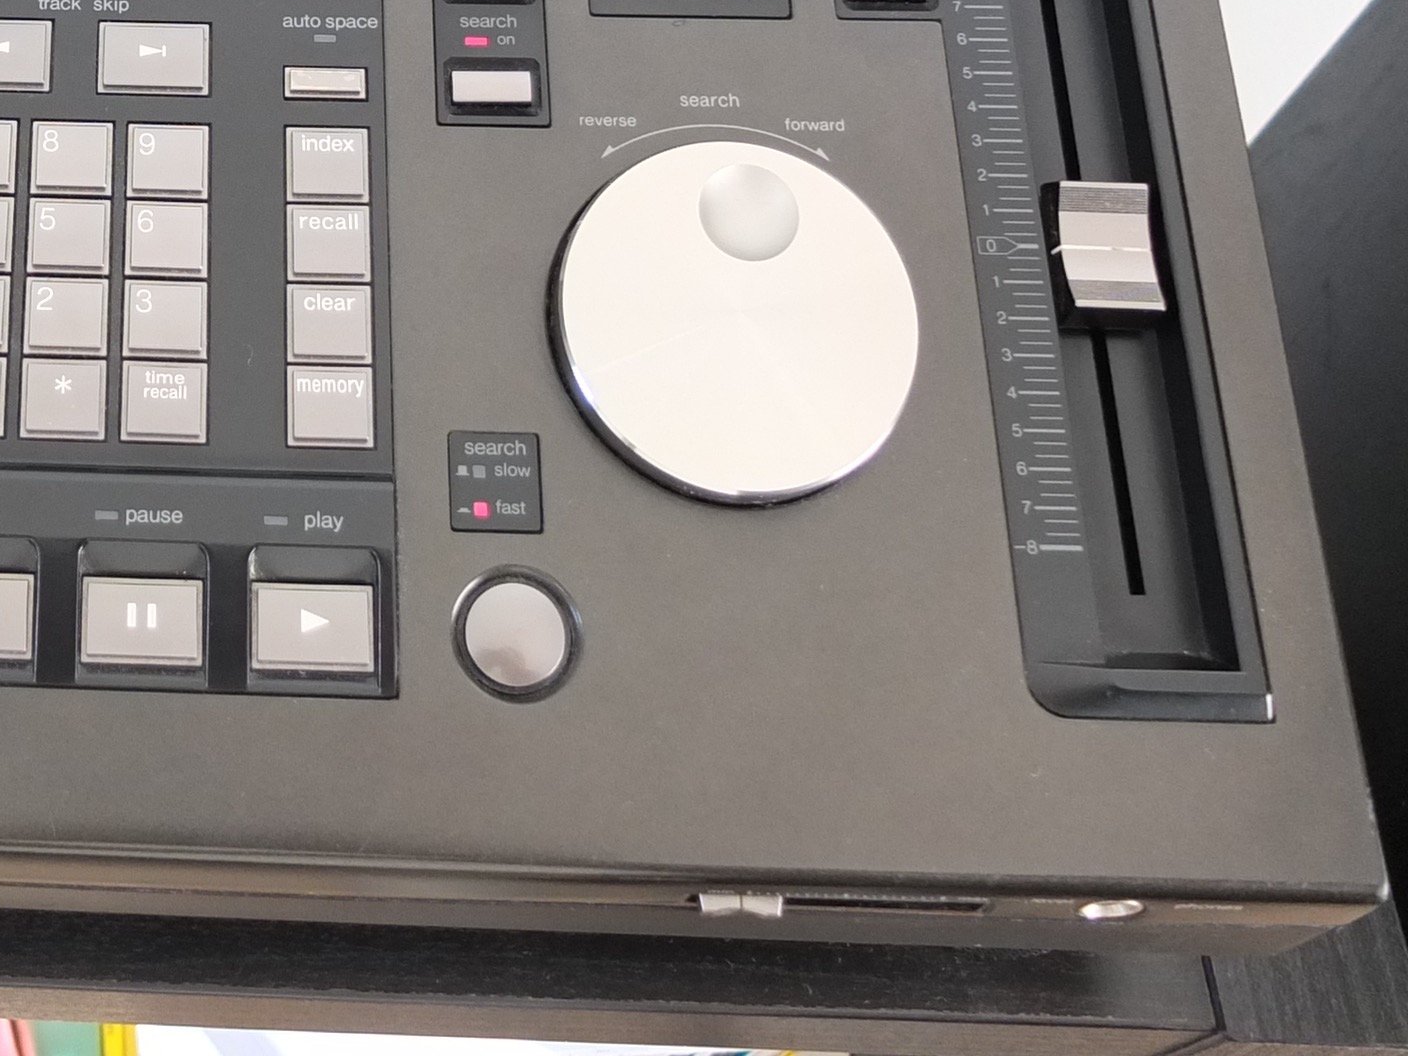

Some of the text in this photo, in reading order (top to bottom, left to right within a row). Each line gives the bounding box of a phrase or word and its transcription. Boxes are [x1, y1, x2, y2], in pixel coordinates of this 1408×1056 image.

[952, 1, 961, 12] 7
[283, 14, 378, 31] auto space
[460, 16, 517, 28] search
[497, 35, 515, 45] on
[957, 33, 967, 44] 6
[963, 67, 973, 79] 5
[680, 94, 740, 107] search
[967, 101, 976, 112] 4
[579, 116, 636, 126] reverse
[785, 118, 844, 131] forward
[43, 130, 59, 152] 8
[139, 133, 156, 155] 9
[301, 134, 354, 152] index
[972, 135, 982, 147] 3
[977, 169, 986, 181] 2
[983, 204, 988, 215] 1
[40, 208, 56, 231] 5
[137, 210, 154, 233] 6
[299, 213, 358, 230] recall
[986, 240, 996, 252] 0
[993, 276, 999, 287] 1
[36, 288, 53, 311] 2
[136, 290, 152, 313] 3
[304, 295, 356, 311] clear
[997, 312, 1006, 324] 2
[1001, 348, 1012, 362] 3
[145, 370, 185, 384] time
[143, 385, 187, 400] recall
[297, 377, 364, 397] memory
[1007, 387, 1017, 398] 4
[1012, 424, 1022, 437] 5
[465, 441, 526, 456] search
[494, 463, 531, 477] slow
[1016, 462, 1028, 475] 6
[496, 499, 526, 514] fast
[1022, 501, 1031, 514] 7
[125, 508, 183, 526] pause
[304, 512, 343, 532] play
